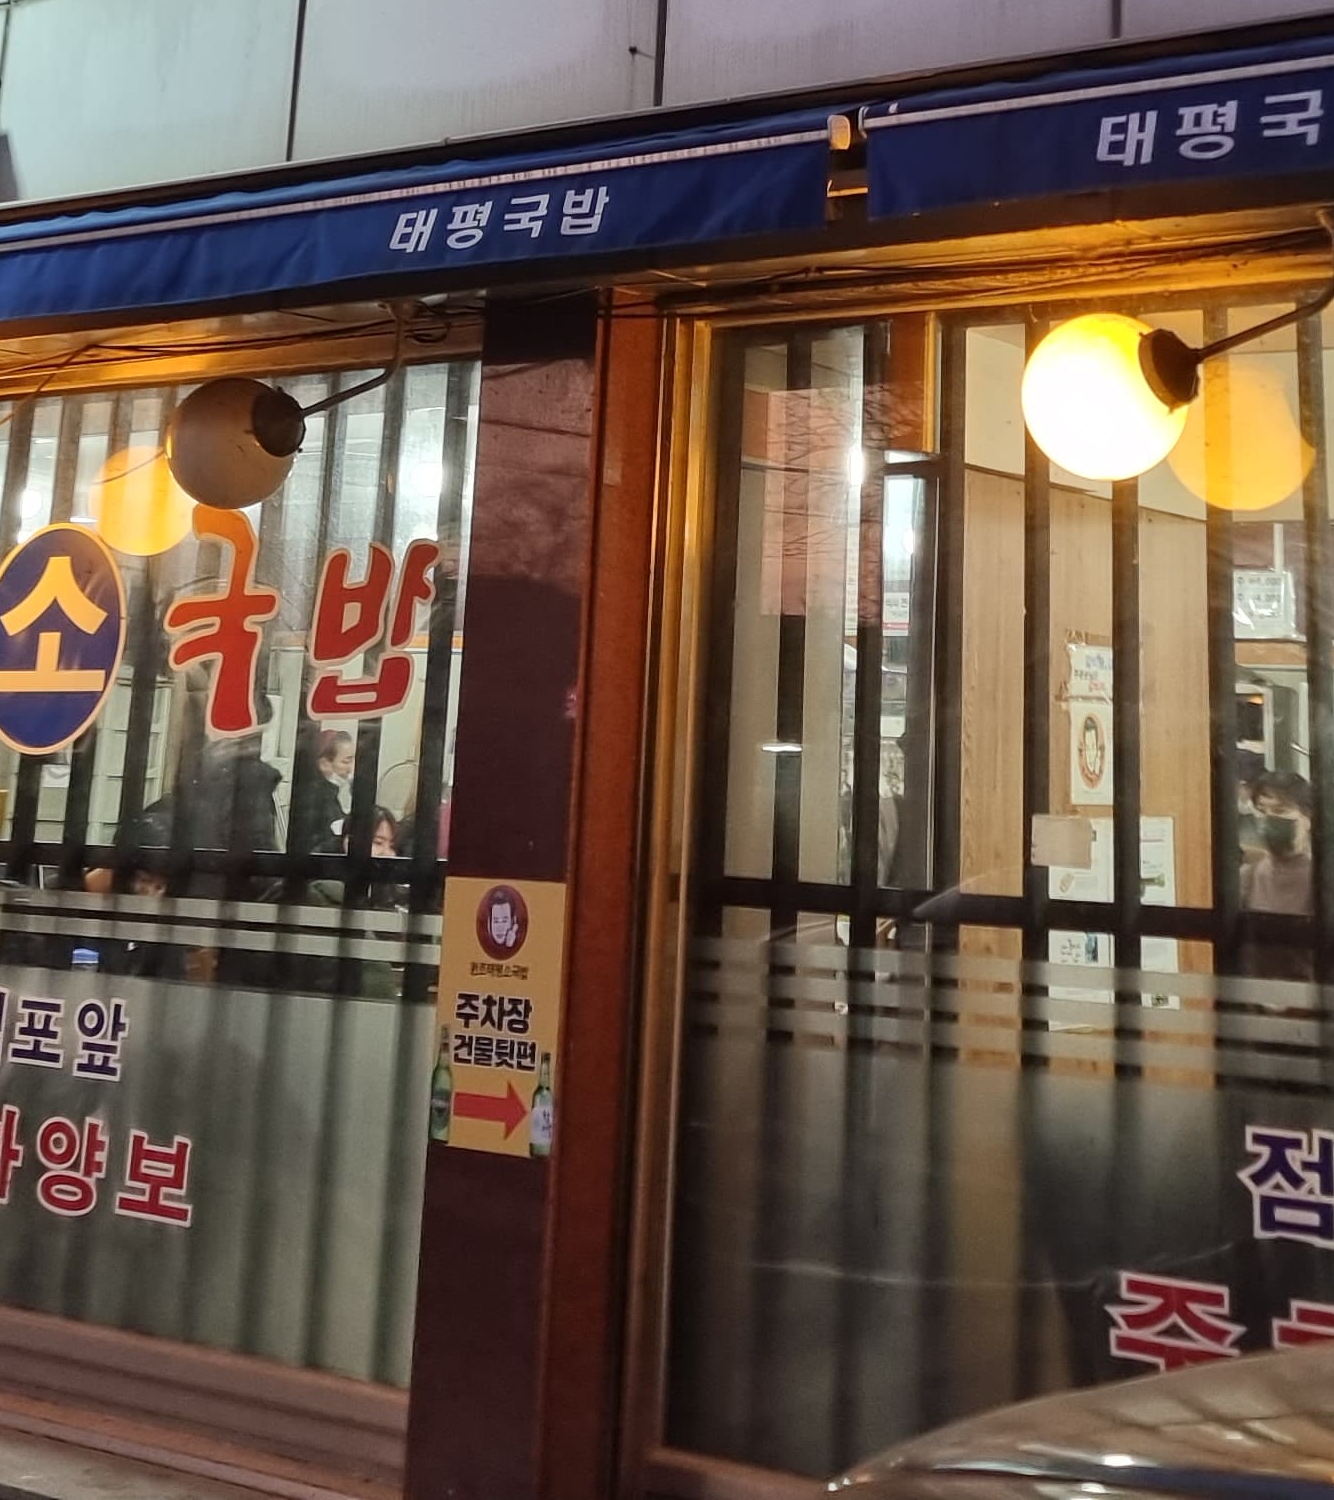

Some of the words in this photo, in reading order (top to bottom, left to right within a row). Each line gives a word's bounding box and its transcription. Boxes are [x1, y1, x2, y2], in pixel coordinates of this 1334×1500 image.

[389, 184, 611, 255] 태평국밥
[167, 504, 442, 740] 국밥
[455, 992, 533, 1035] 주차장
